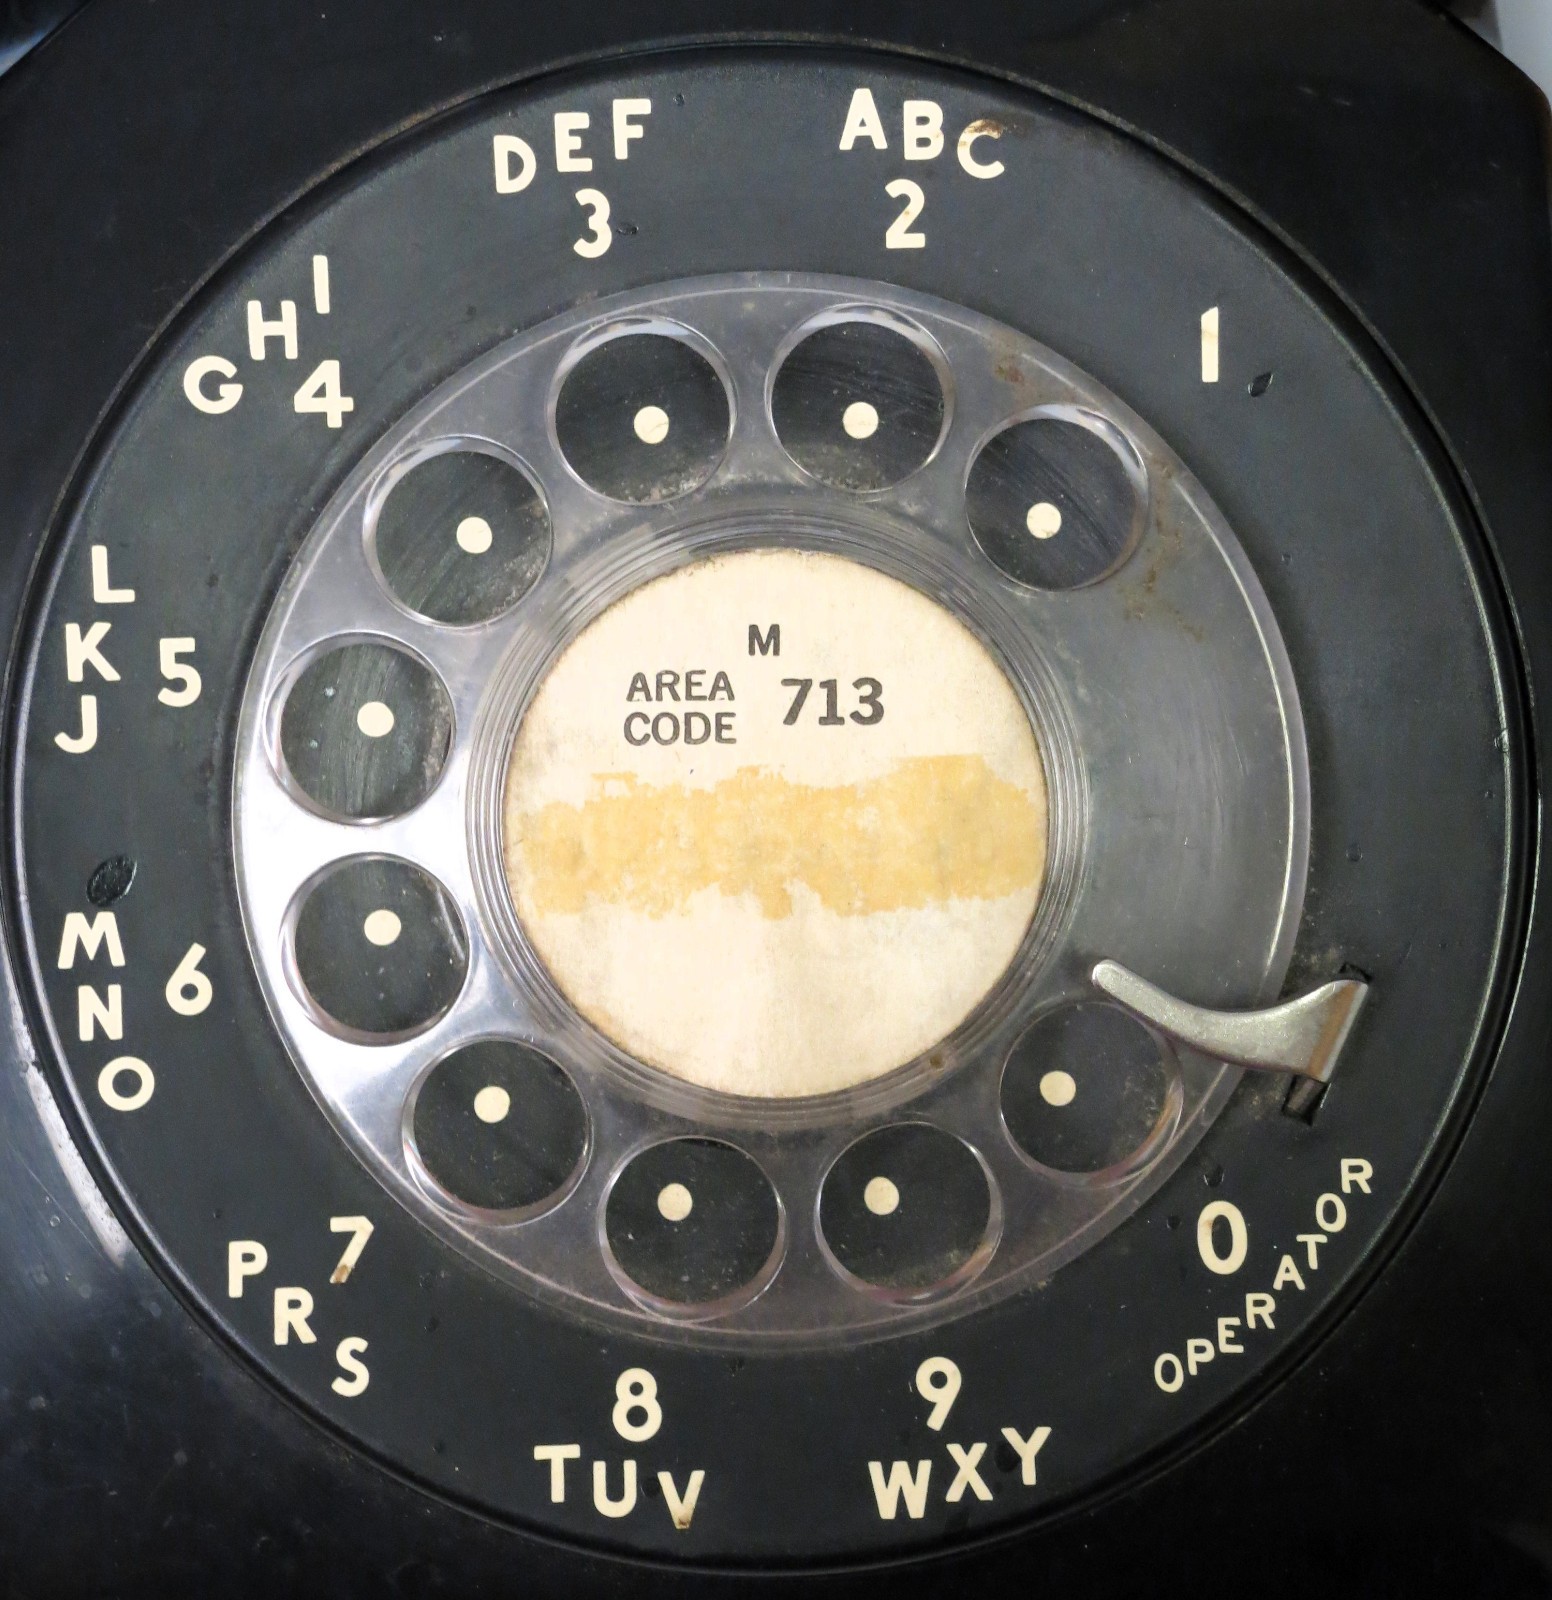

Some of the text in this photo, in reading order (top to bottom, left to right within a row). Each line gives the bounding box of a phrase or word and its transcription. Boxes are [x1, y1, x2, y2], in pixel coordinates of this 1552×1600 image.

[493, 97, 652, 194] DEF
[839, 88, 1006, 179] ABC
[573, 188, 612, 258] 3
[885, 178, 926, 249] 2
[181, 254, 331, 414] GHI
[291, 359, 354, 428] 4
[158, 637, 202, 707] 5
[749, 624, 780, 655] M
[627, 670, 734, 701] AREA
[781, 678, 884, 725] 713
[624, 712, 735, 745] CODE
[58, 911, 155, 1111] MNO
[165, 942, 213, 1016] 6
[330, 1216, 374, 1283] 7
[1154, 1159, 1373, 1392] OPERATOR
[228, 1240, 369, 1397] PRS
[612, 1368, 662, 1442] 8
[916, 1357, 961, 1431] 9
[534, 1444, 705, 1529] TUV
[868, 1427, 1051, 1519] WXY
